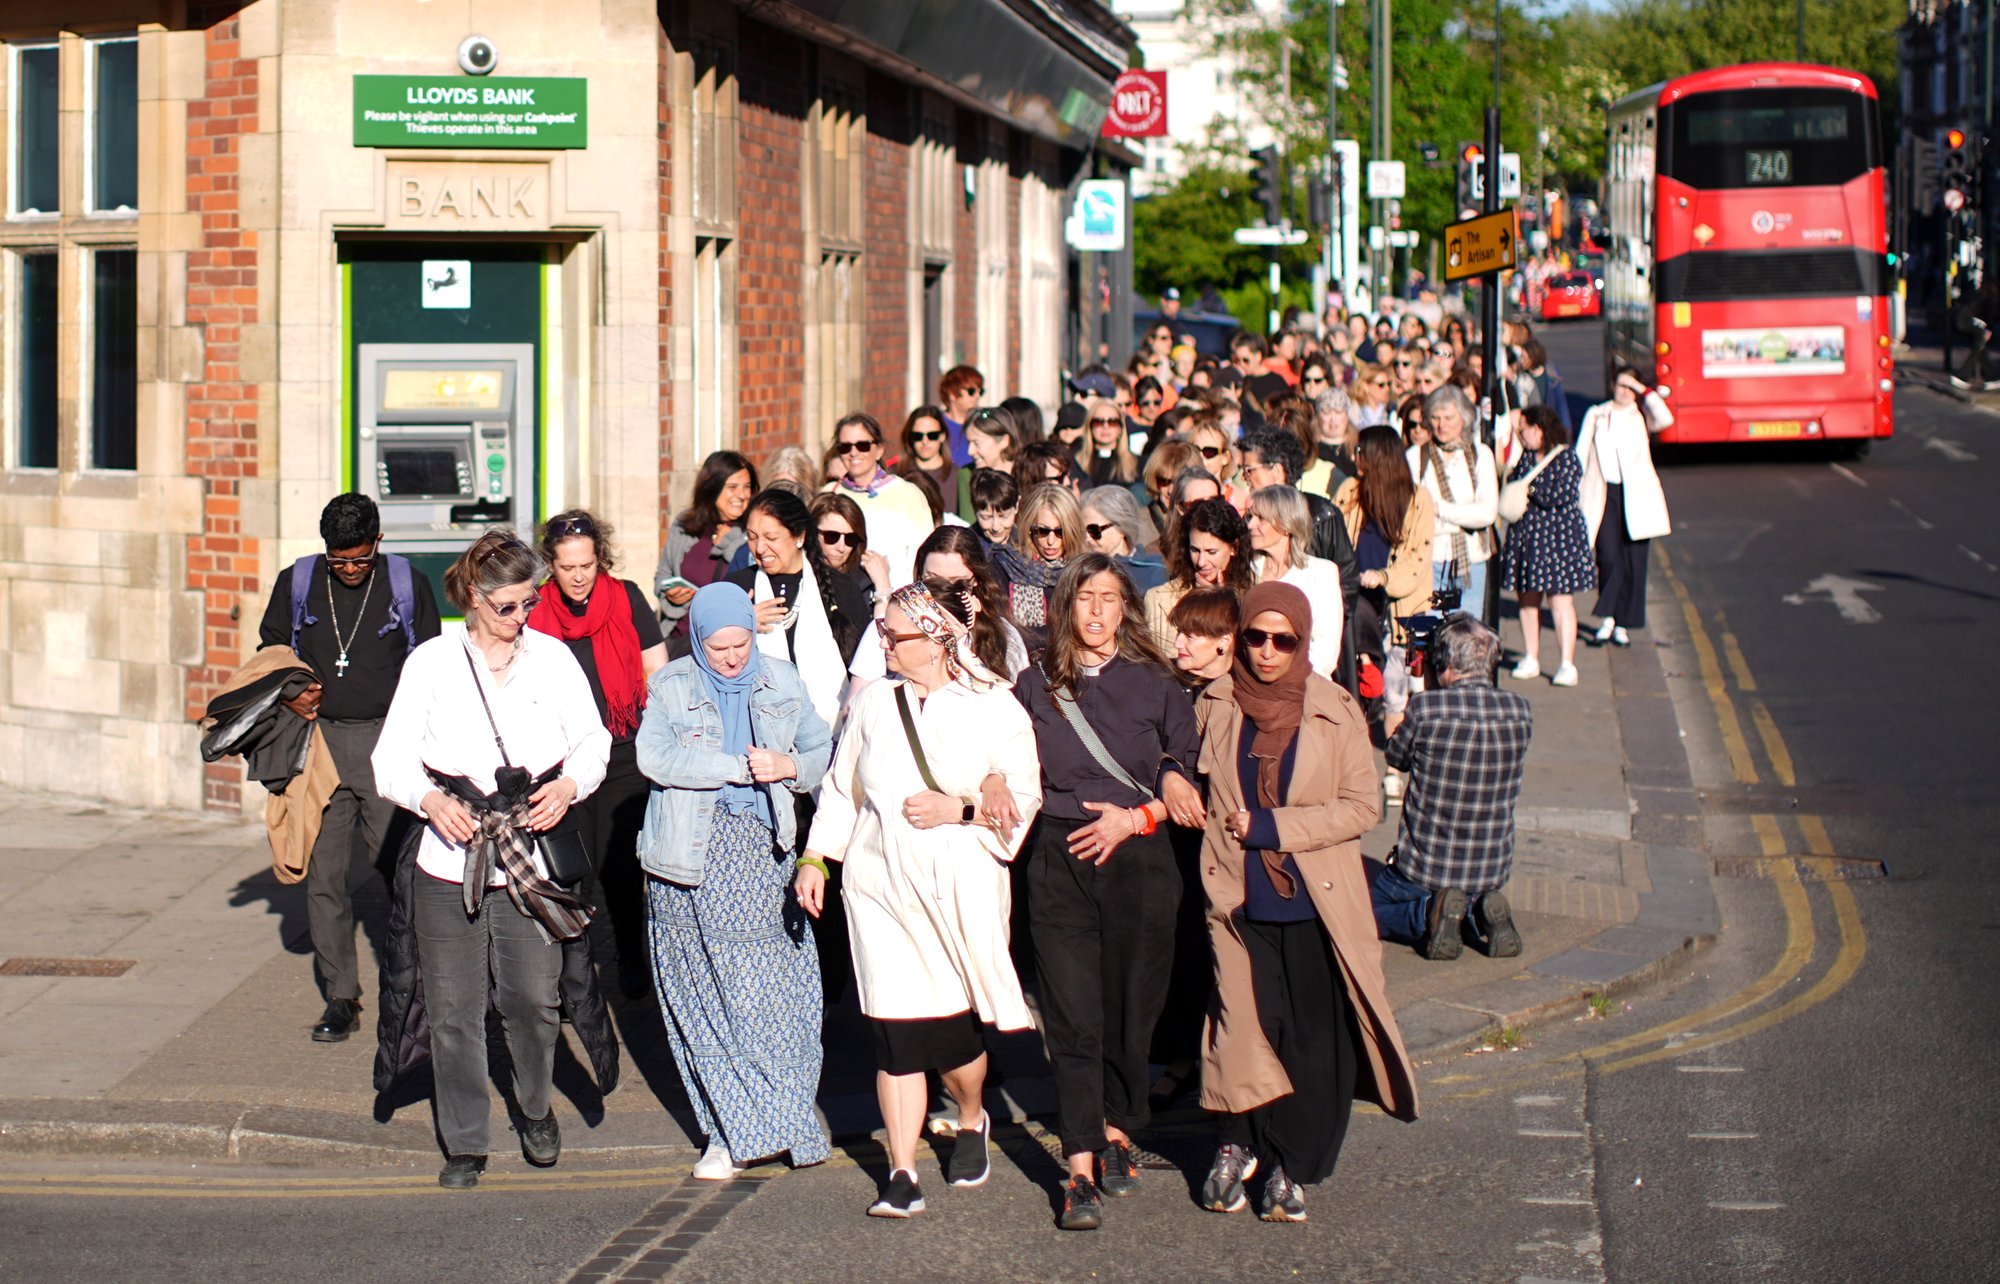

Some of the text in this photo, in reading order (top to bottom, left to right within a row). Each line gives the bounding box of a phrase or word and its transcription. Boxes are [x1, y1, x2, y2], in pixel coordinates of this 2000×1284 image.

[407, 87, 535, 105] LLOYDS BANK
[364, 110, 397, 121] Please
[398, 110, 412, 121] be
[413, 110, 449, 124] vigilant
[450, 111, 478, 122] when
[479, 111, 505, 125] using
[506, 113, 523, 122] our
[406, 122, 538, 136] Thieves operate in this area
[1749, 151, 1788, 182] 240
[399, 176, 535, 218] BANK
[1466, 231, 1480, 246] The
[1468, 248, 1496, 264] Artisan
